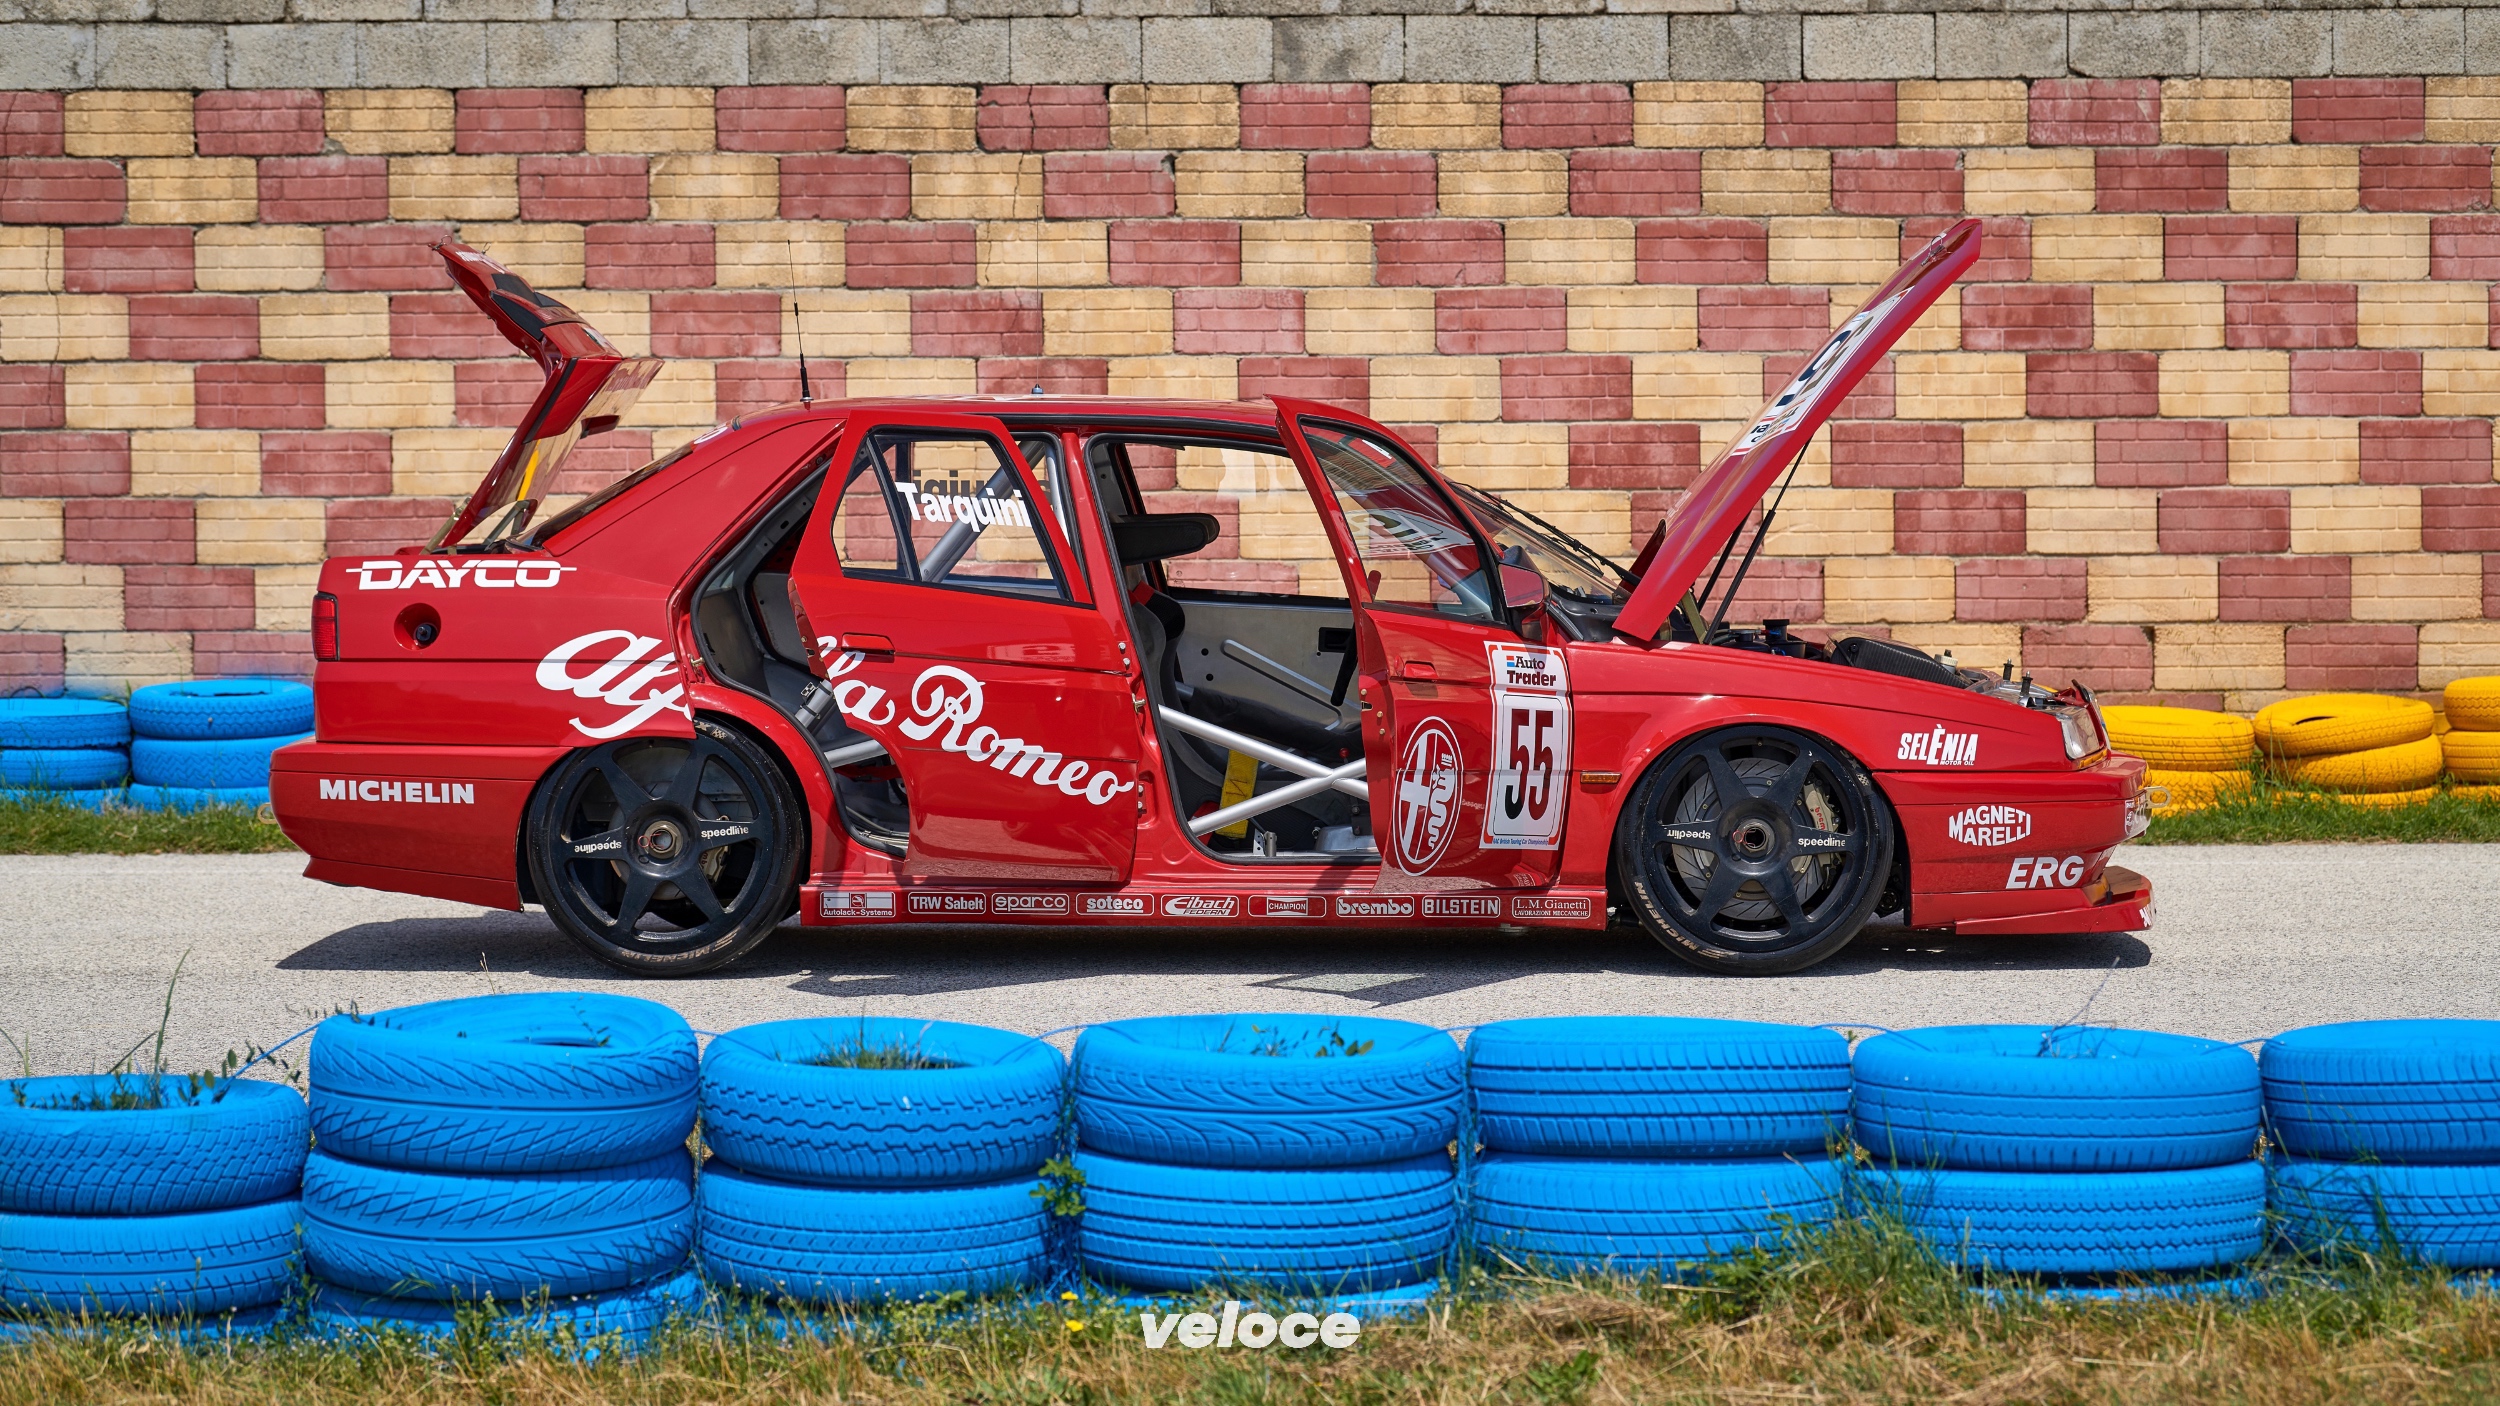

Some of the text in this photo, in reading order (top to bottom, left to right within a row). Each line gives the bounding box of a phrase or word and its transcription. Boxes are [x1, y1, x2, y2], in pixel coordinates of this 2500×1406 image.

[894, 481, 1032, 533] Tarquini
[346, 560, 577, 590] DAYCO
[1515, 656, 1546, 670] Auto
[1507, 670, 1557, 687] Trader
[898, 665, 1135, 805] Romeo
[1897, 724, 1979, 766] SELÈNIA
[1504, 708, 1554, 821] 55
[319, 779, 475, 804] MICHELIN
[701, 825, 749, 840] speedline
[574, 840, 622, 853] speedline
[1798, 837, 1846, 848] speedline
[2005, 855, 2085, 890] ERG
[911, 896, 984, 911] TRW Sabelt
[995, 896, 1066, 911] sparco
[1086, 897, 1144, 910] soteco
[1165, 896, 1235, 915] Eibach
[1268, 902, 1306, 911] CHAMPION
[1338, 899, 1413, 915] brembo
[1424, 899, 1498, 915] BILSTEIN
[1545, 899, 1587, 910] Gianetti
[823, 908, 893, 917] Autolack-Systeme
